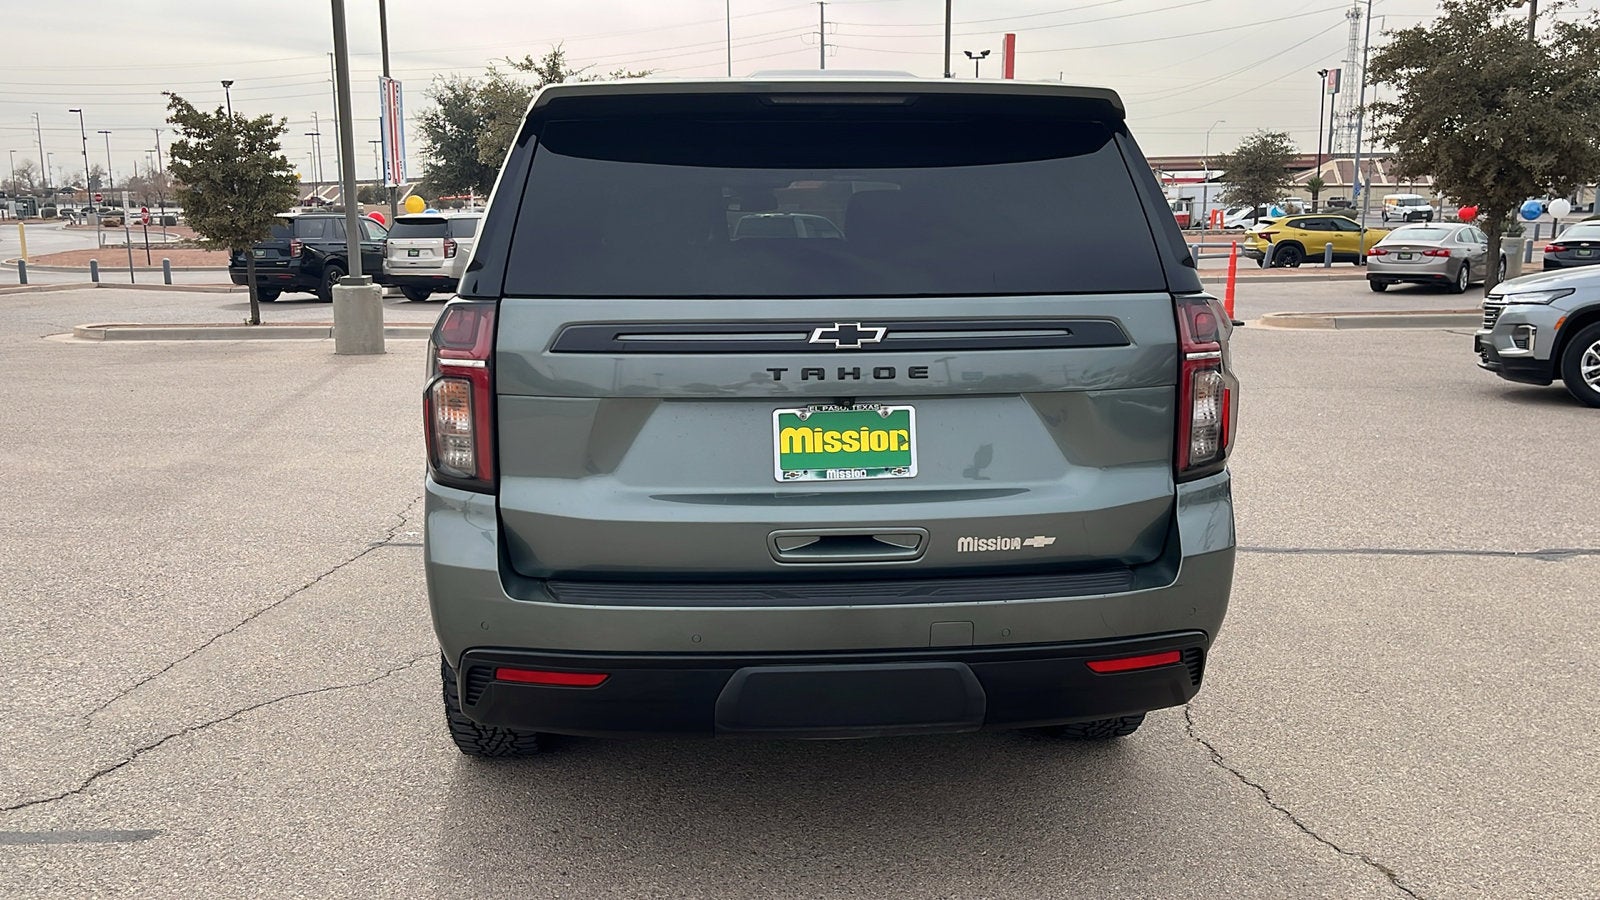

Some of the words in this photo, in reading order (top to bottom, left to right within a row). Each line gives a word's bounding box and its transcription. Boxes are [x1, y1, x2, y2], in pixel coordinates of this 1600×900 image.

[766, 366, 929, 381] TAHOE
[780, 426, 909, 454] Mission
[957, 535, 1022, 553] Mission
